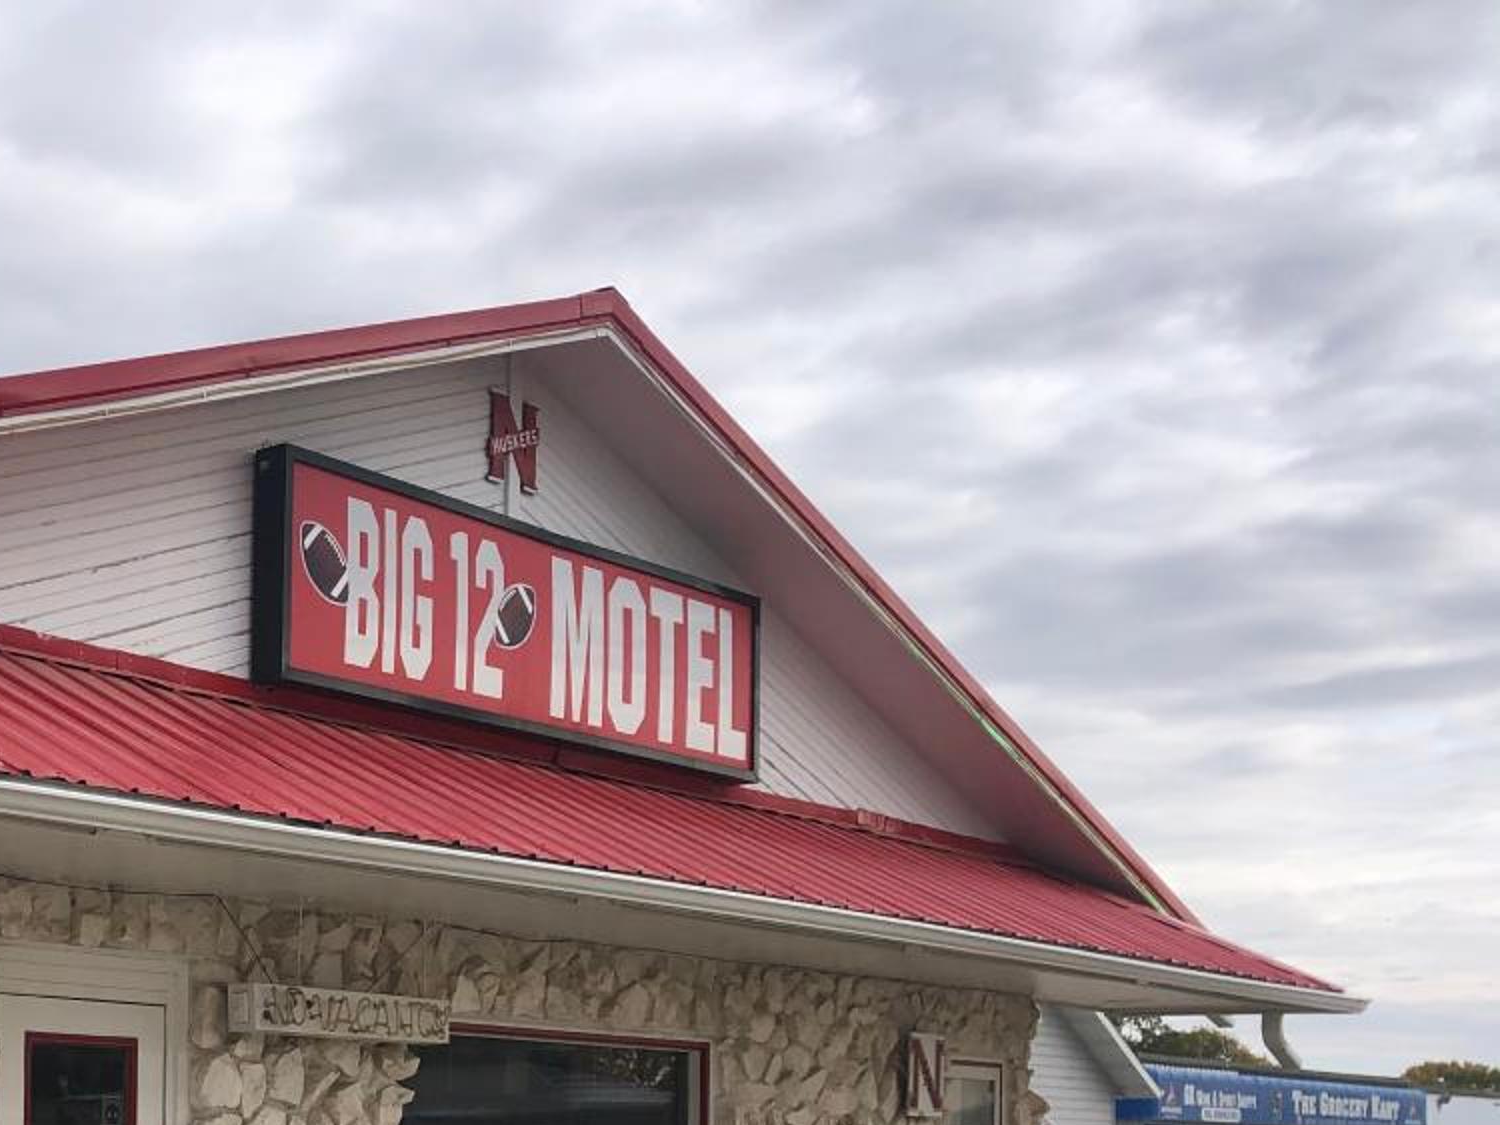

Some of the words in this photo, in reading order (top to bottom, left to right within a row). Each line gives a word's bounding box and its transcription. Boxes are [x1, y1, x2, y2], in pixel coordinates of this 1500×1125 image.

[485, 385, 541, 494] N
[343, 496, 434, 681] BIG
[449, 531, 505, 698] 12
[549, 555, 747, 761] MOTEL
[907, 1034, 945, 1116] N
